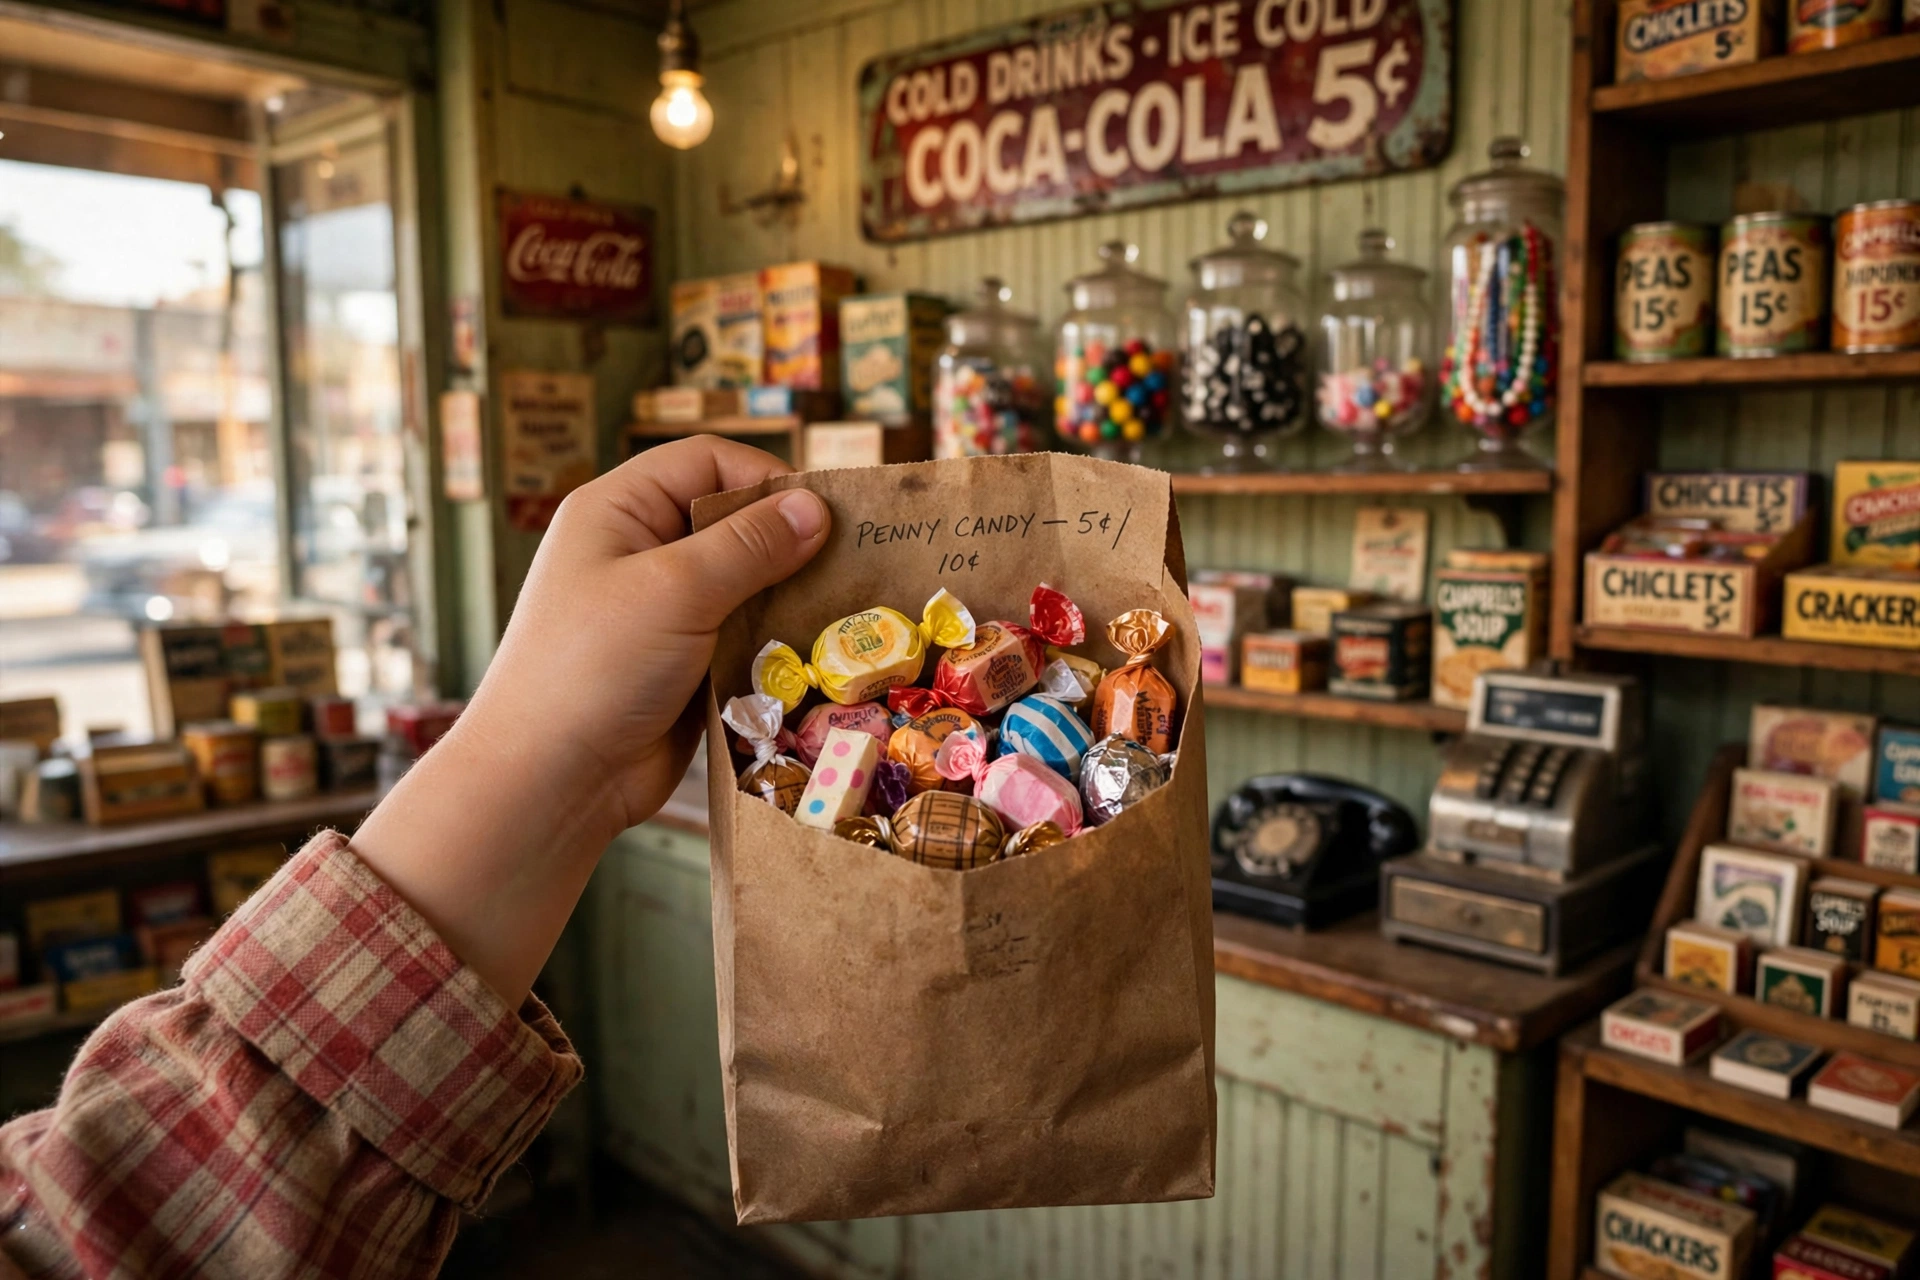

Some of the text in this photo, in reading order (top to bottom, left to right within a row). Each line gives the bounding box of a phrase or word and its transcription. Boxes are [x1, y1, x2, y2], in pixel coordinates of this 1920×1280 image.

[887, 62, 977, 126] COLD
[987, 25, 1133, 102] DRINKS
[1168, 1, 1241, 67] ICE
[906, 37, 1411, 207] COCA-COLA 5¢
[1621, 254, 1692, 292] PEAS
[1726, 248, 1803, 287] PEAS
[1632, 298, 1680, 331] 15¢
[1740, 291, 1789, 326] 15¢
[1858, 288, 1906, 323] 15¢
[1657, 478, 1787, 510] CHICLETS
[857, 518, 941, 548] PENNY
[955, 512, 1035, 538] CANDY
[938, 551, 980, 575] 10¢
[1602, 567, 1736, 602] CHICLETS
[1704, 603, 1731, 629] 5¢
[1796, 589, 1920, 628] CRACKER
[1452, 611, 1509, 643] SOUP
[1604, 1208, 1720, 1274] CRACKERS
